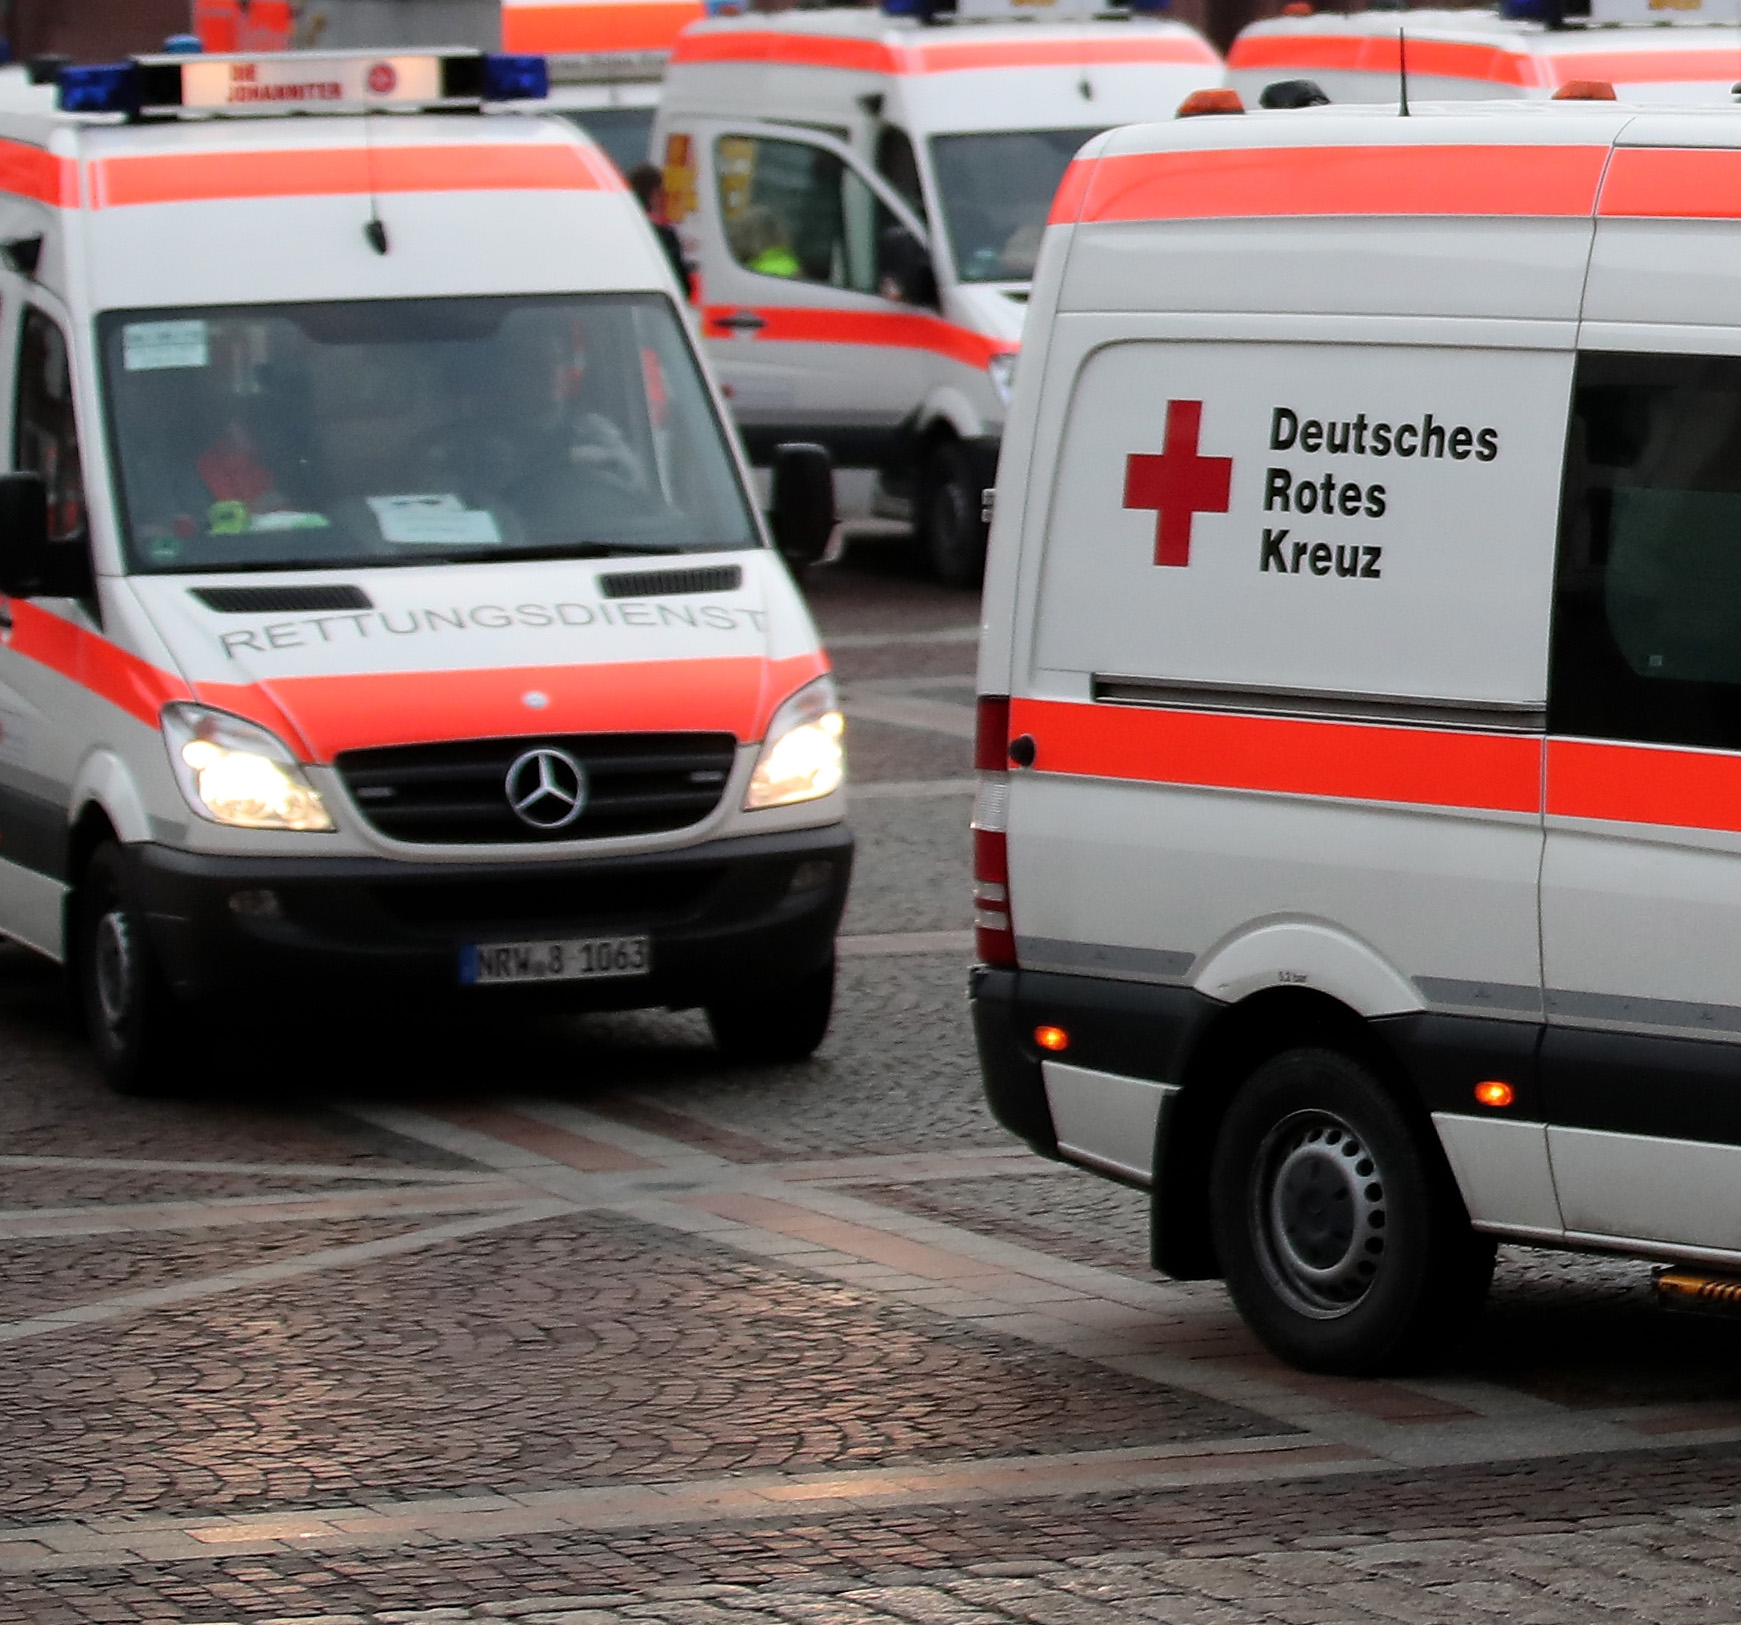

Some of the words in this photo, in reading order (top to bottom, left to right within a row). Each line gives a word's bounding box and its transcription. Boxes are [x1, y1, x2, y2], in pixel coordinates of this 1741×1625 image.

[1269, 406, 1499, 462] Deutsches
[1263, 467, 1387, 519] Rotes
[1258, 528, 1383, 580] Kreuz
[218, 600, 770, 660] RETTUNGSDIENST
[478, 946, 530, 978] NRW
